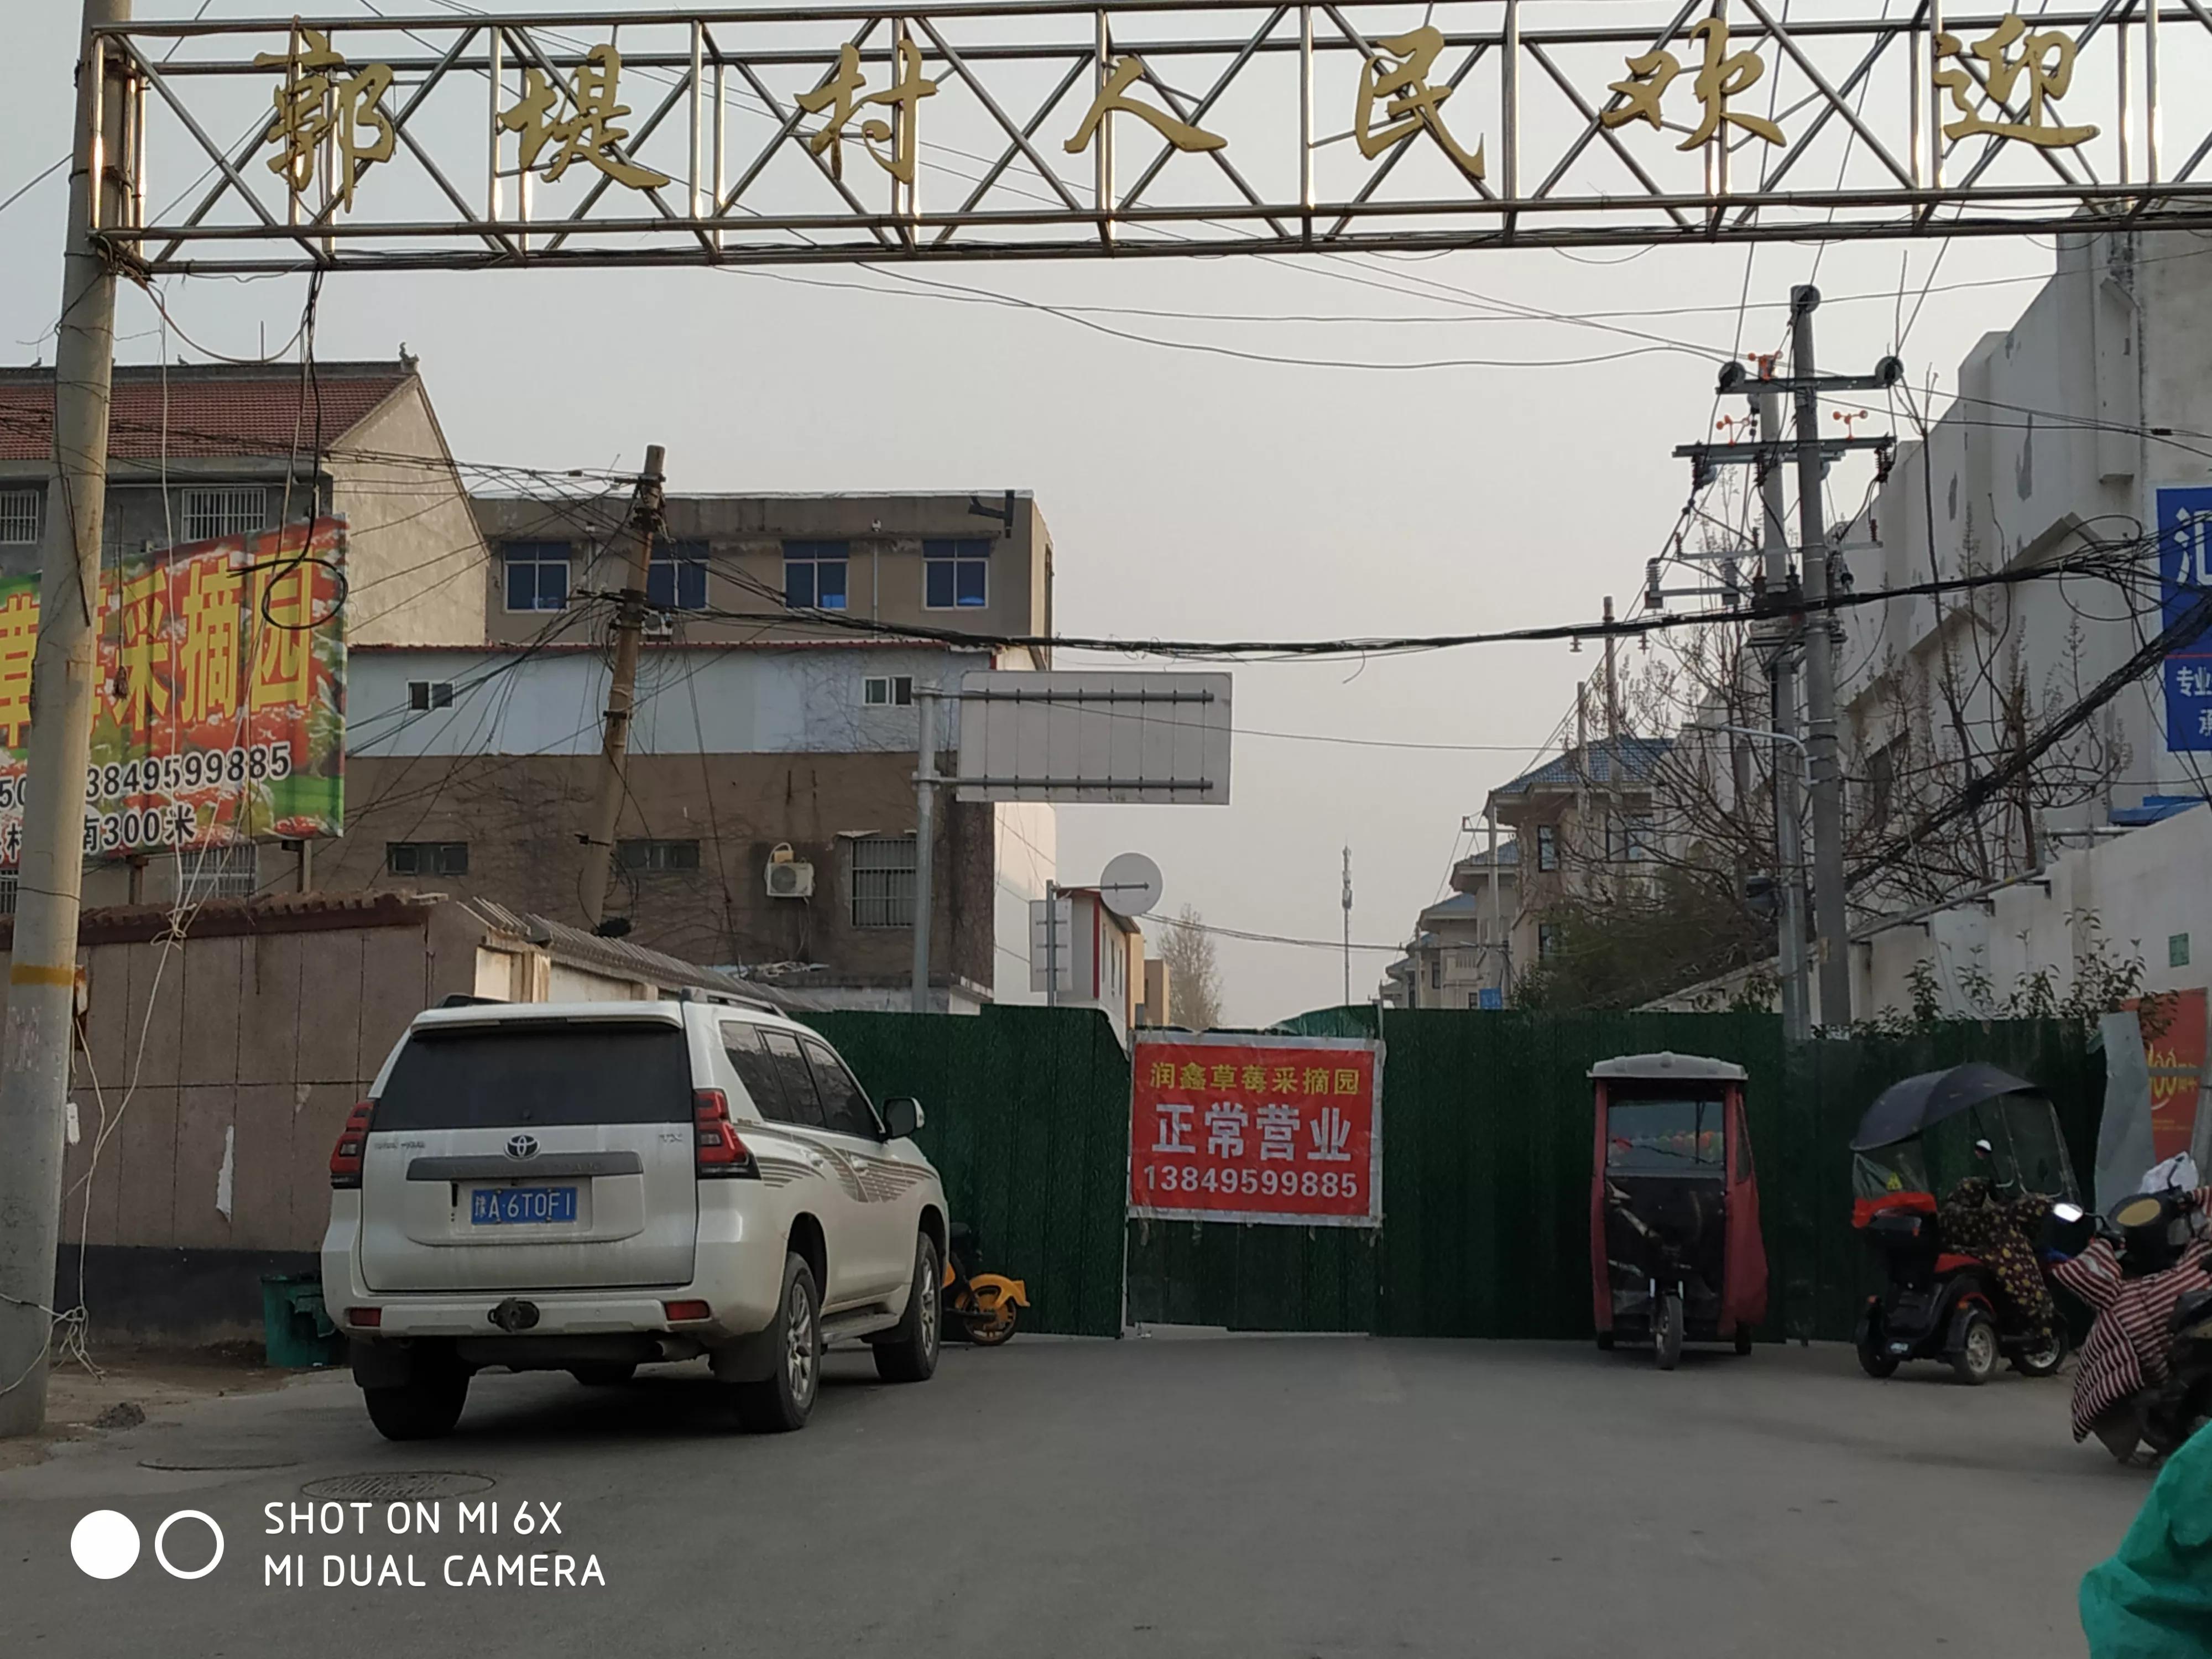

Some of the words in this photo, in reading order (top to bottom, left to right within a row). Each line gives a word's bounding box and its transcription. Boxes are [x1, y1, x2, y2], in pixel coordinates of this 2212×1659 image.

[0, 551, 315, 748] 草采摘园
[84, 743, 290, 800] 3849599885
[1150, 1062, 1360, 1095] 润鑫草莓采摘园
[1151, 1101, 1352, 1162] 正常营业
[1144, 1165, 1358, 1198] 13849599885
